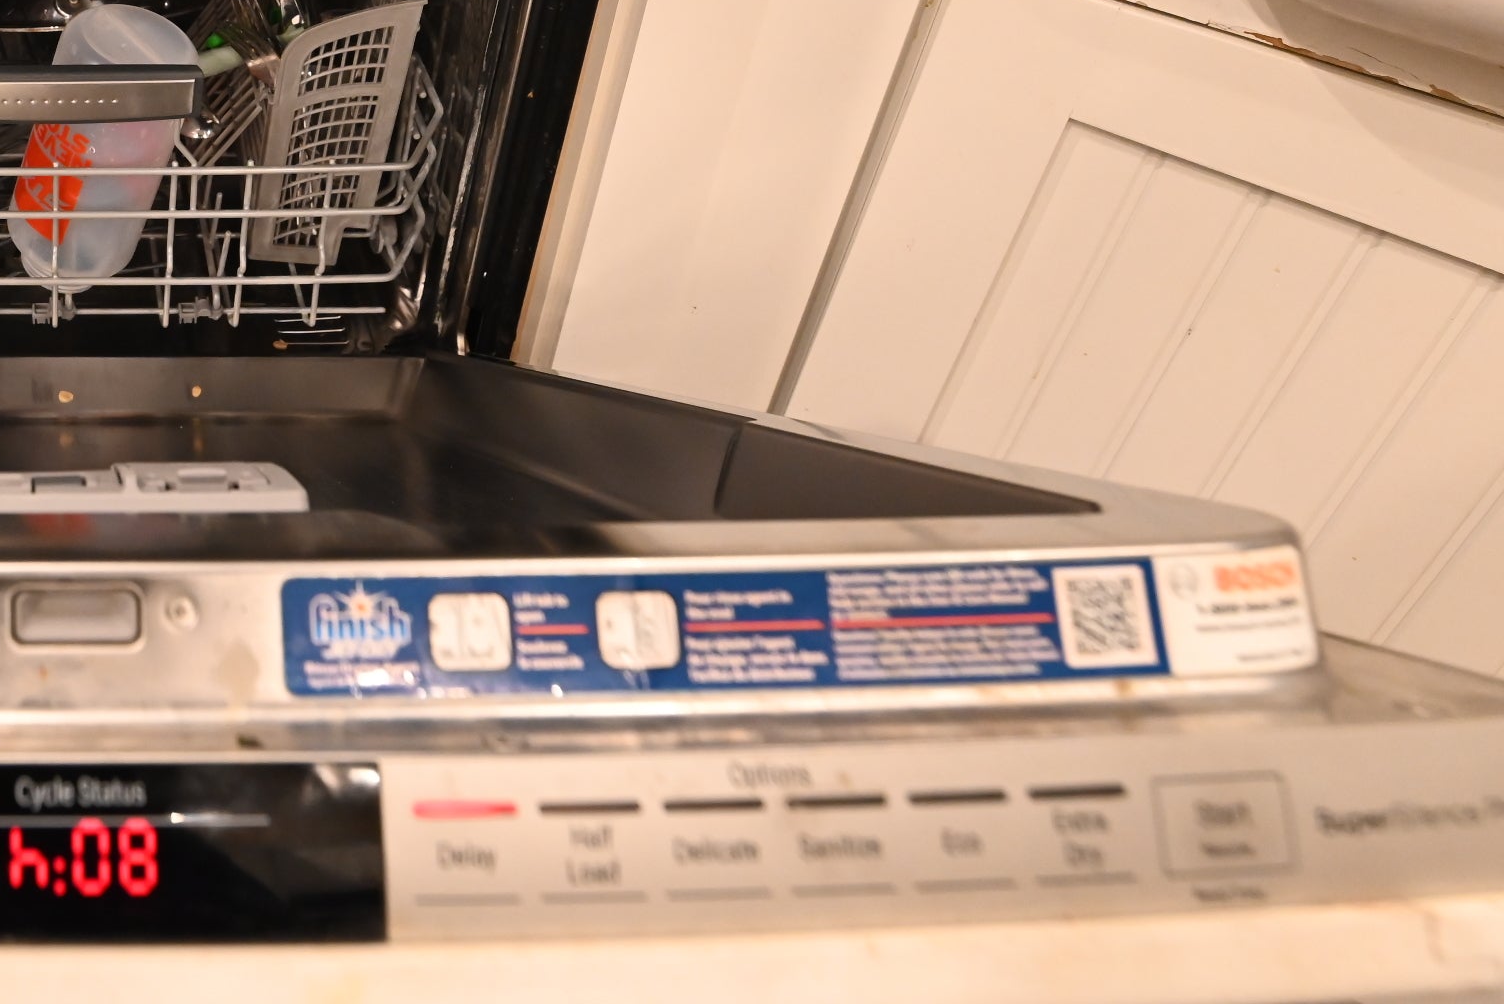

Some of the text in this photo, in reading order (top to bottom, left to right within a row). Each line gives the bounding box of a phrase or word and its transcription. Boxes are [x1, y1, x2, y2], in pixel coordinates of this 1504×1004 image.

[730, 761, 810, 789] Options
[15, 777, 146, 810] Cycle Status
[437, 842, 496, 870] Delay
[673, 837, 758, 862] Delicate
[567, 861, 620, 885] Load
